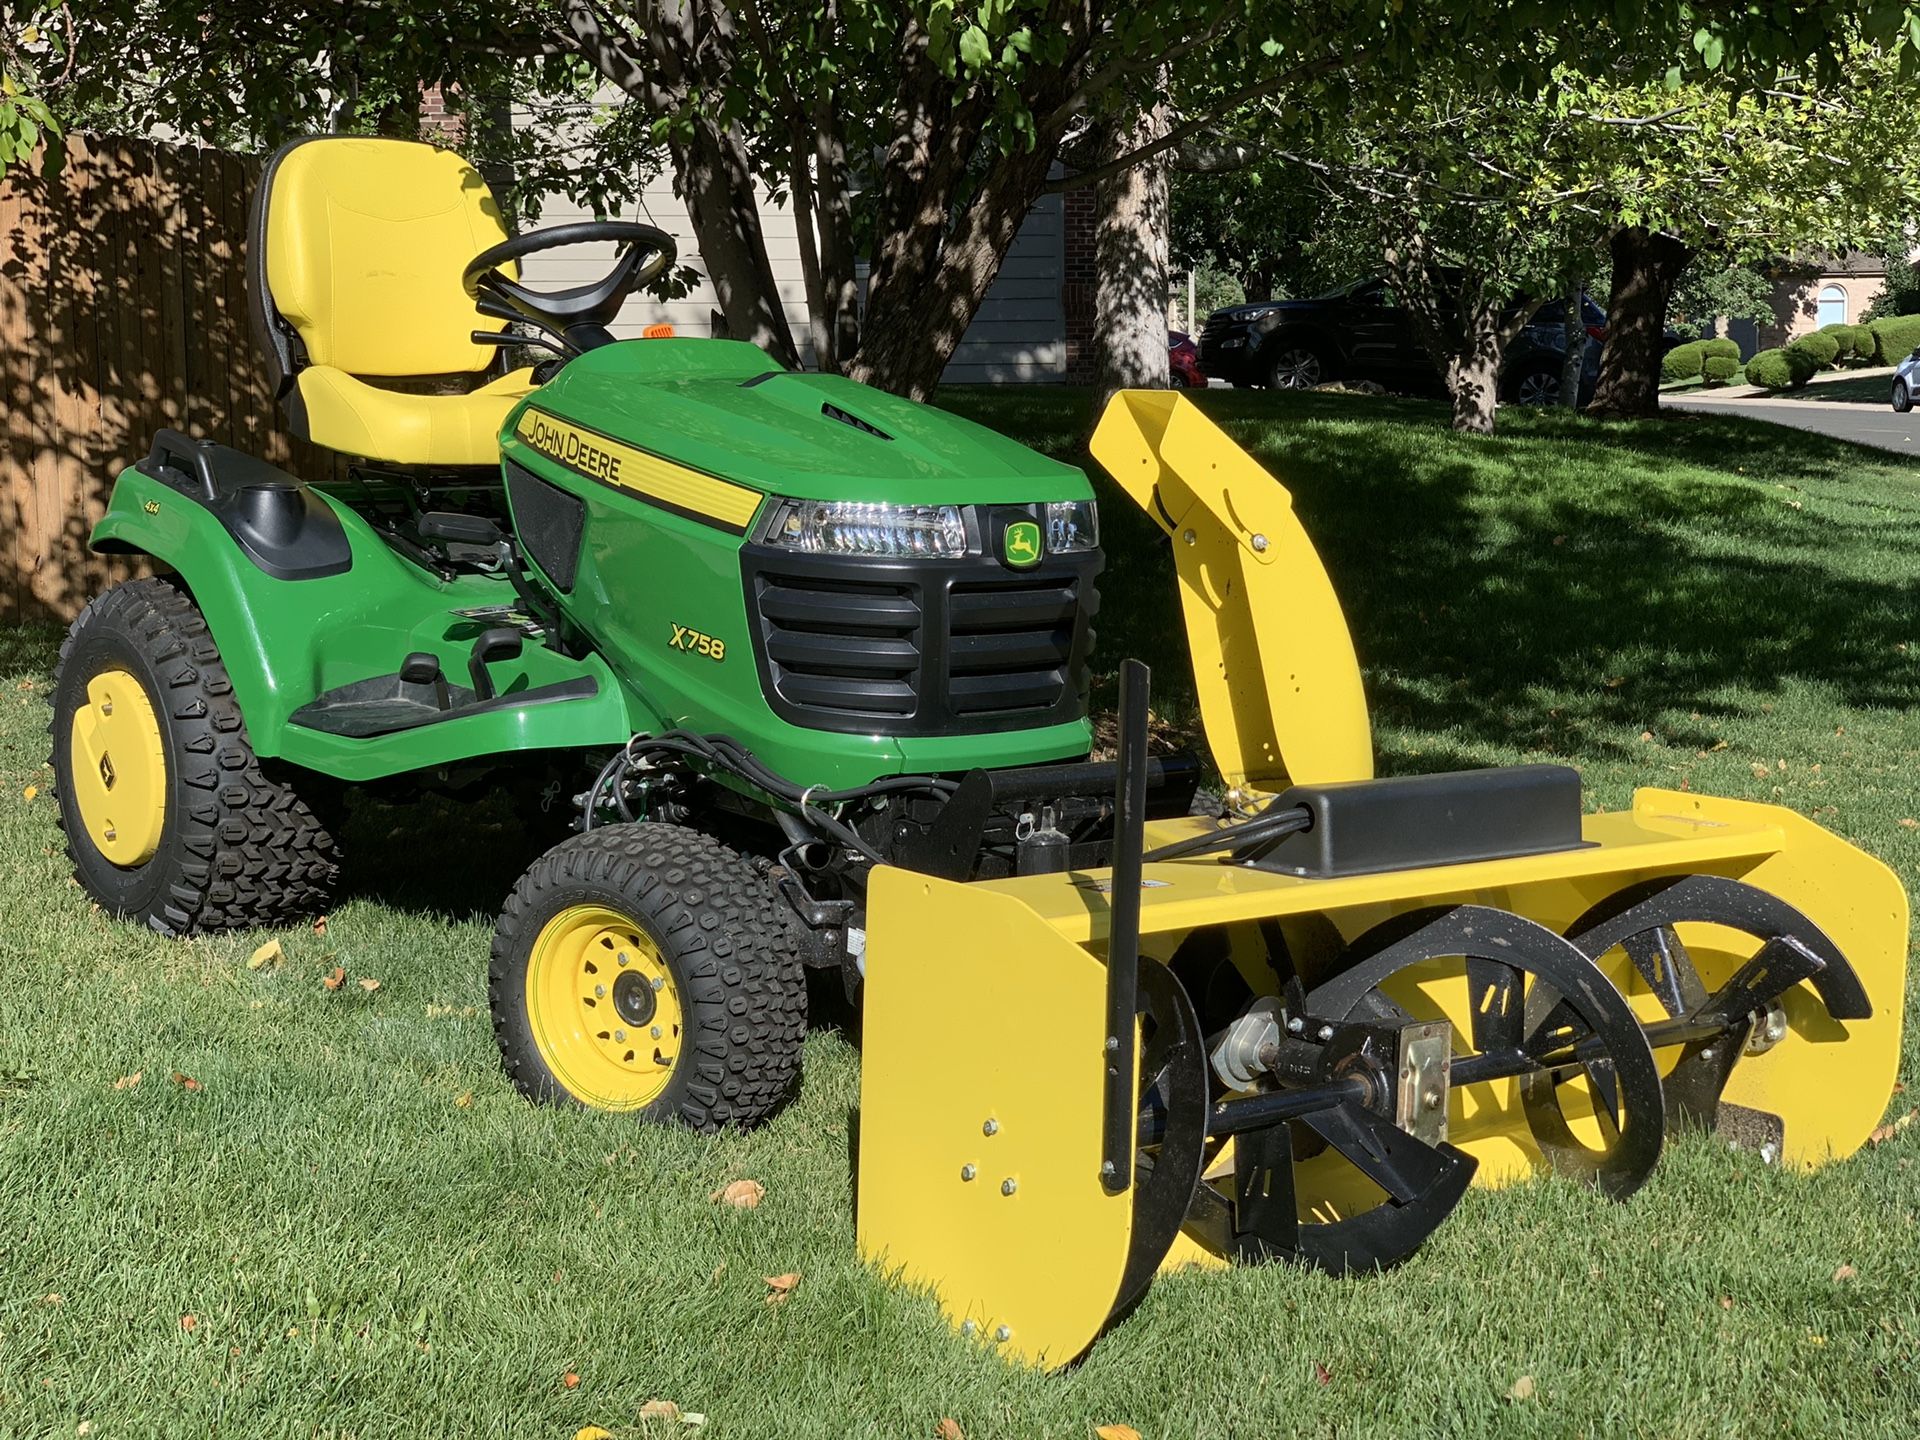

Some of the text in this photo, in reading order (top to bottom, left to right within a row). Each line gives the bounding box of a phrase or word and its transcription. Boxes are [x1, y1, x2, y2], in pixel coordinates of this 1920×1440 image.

[528, 415, 622, 482] JOHN DEERE
[668, 622, 725, 661] X758
